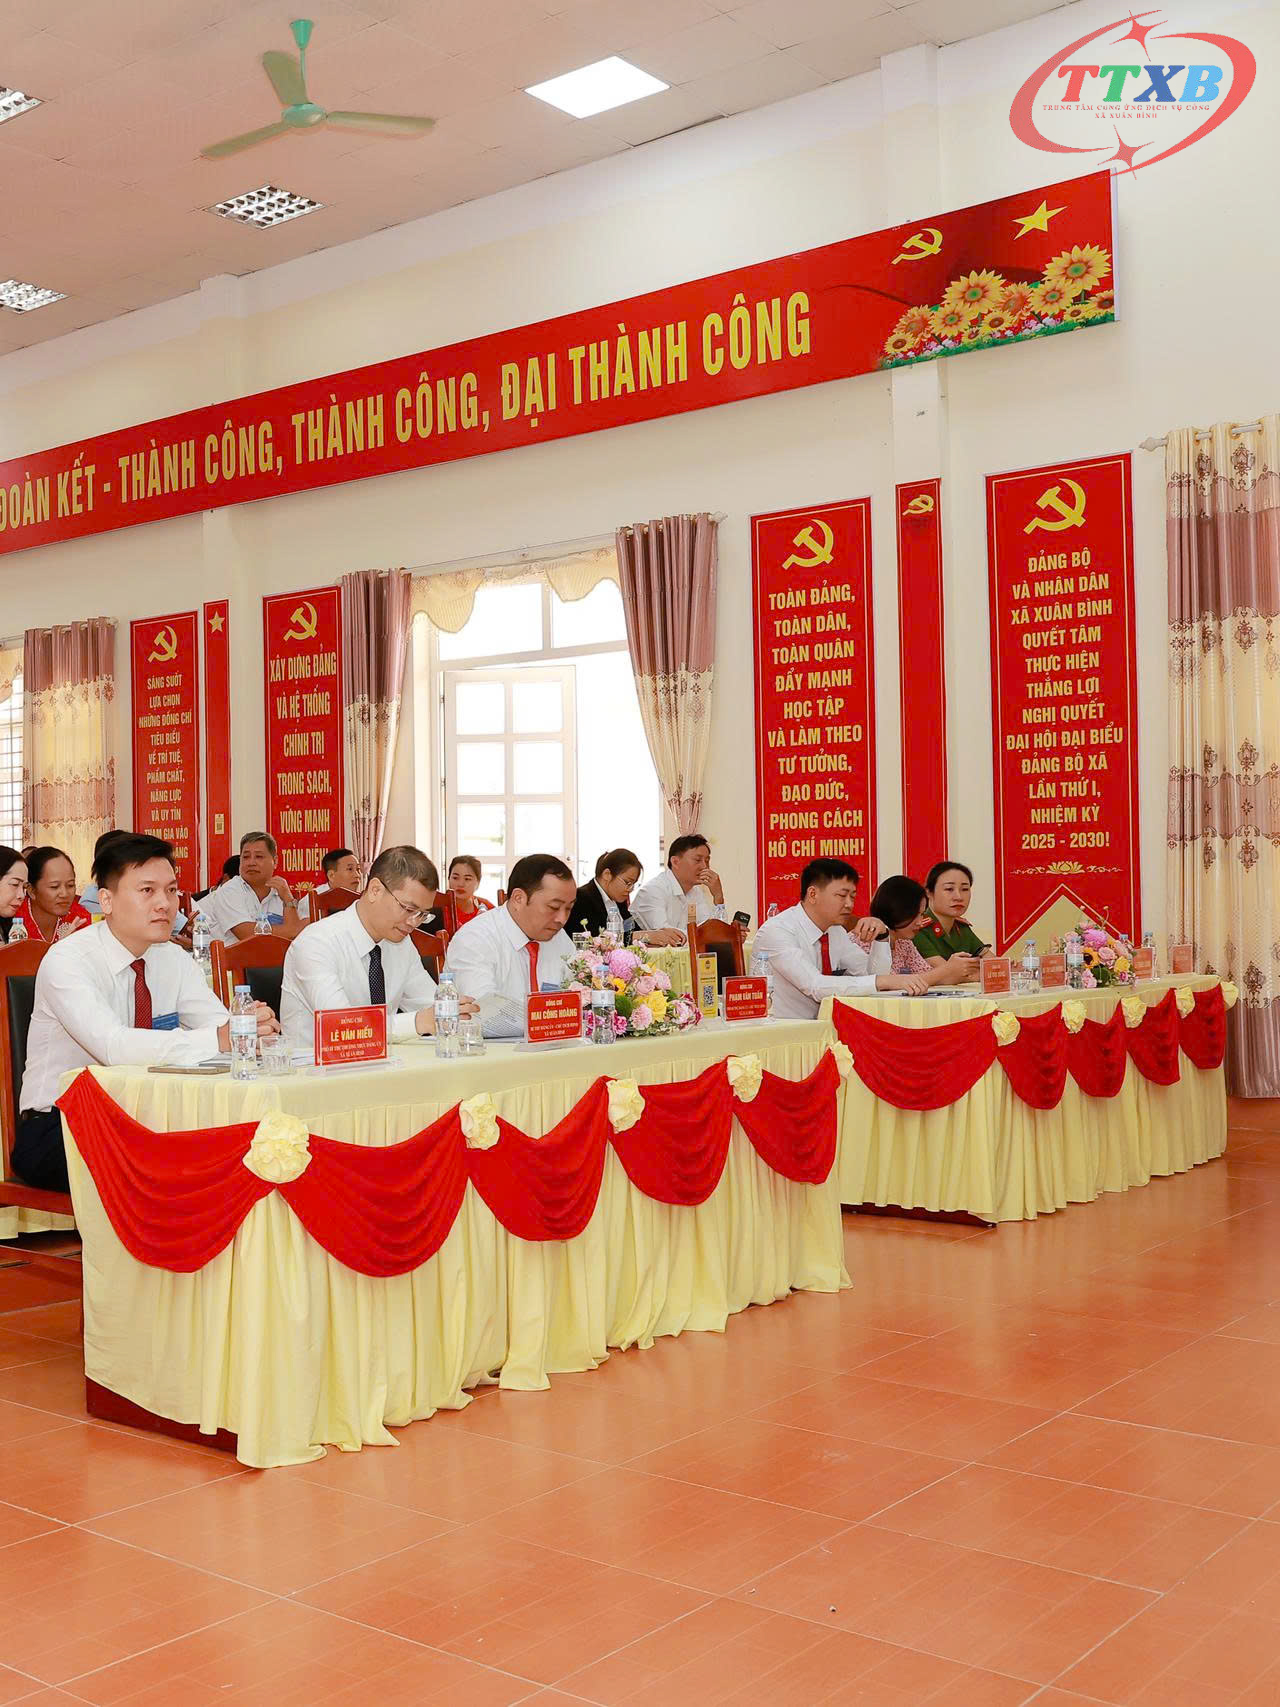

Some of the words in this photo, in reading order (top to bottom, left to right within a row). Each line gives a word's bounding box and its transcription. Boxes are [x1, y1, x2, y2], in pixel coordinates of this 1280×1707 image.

[57, 452, 95, 518] KẾT
[119, 439, 195, 503] THÀNH
[205, 419, 283, 484] CÔNG,
[291, 394, 384, 464] THÀNH
[395, 371, 489, 443] CÔNG,
[501, 353, 556, 427] ĐẠI
[568, 322, 688, 405] THÀNH
[702, 291, 810, 375] CÔNG
[1028, 550, 1067, 573] ĐẢNG
[1072, 547, 1090, 569] BỘ
[769, 588, 806, 610] TOÀN
[810, 580, 855, 605] ĐẢNG,
[1012, 581, 1030, 600] VÀ
[1035, 576, 1074, 597] NHÂN
[1079, 572, 1109, 592] DÂN
[774, 615, 811, 637] TOÀN
[816, 611, 850, 632] DÂN,
[1011, 606, 1030, 625] XÃ
[1034, 602, 1072, 622] XUÂN
[1077, 598, 1112, 617] BÌNH
[1023, 625, 1066, 650] QUYẾT
[1070, 625, 1101, 644] TÂM
[270, 654, 285, 682] XÂY
[288, 654, 311, 684] DỰNG
[313, 643, 336, 677] ĐẢNG
[772, 643, 809, 664] TOÀN
[814, 638, 854, 662] QUÂN
[1025, 655, 1061, 675] THỰC
[1066, 650, 1099, 672] HIỆN
[147, 675, 164, 689] SÁNG
[166, 670, 182, 688] SUỐT
[776, 667, 803, 692] ĐẨY
[808, 669, 851, 691] MẠNH
[1078, 677, 1099, 697] LỢI
[181, 708, 192, 724] CHÍ
[277, 692, 287, 719] VÀ
[290, 690, 300, 723] HỆ
[302, 684, 330, 717] THỐNG
[784, 700, 812, 722] HỌC
[817, 695, 844, 719] TẬP
[1022, 707, 1056, 725] NGHỊ
[1061, 698, 1104, 722] QUYẾT
[284, 728, 309, 757] CHÍNH
[311, 731, 324, 759] TRỊ
[768, 727, 786, 747] VÀ
[790, 725, 820, 746] LÀM
[825, 725, 862, 743] THEO
[1007, 734, 1029, 752] ĐẠI
[1034, 729, 1056, 751] HỘI
[1062, 730, 1085, 749] ĐẠI
[1090, 722, 1123, 744] BIỂU
[158, 750, 168, 764] TRÍ
[778, 755, 797, 774] TƯ
[800, 748, 852, 773] TƯỞNG,
[1022, 752, 1060, 774] ĐẢNG
[1065, 753, 1083, 774] BỘ
[1088, 752, 1108, 770] XÃ
[277, 772, 304, 795] TRONG
[307, 770, 332, 798] SẠCH,
[782, 784, 810, 805] ĐẠO
[815, 778, 848, 800] ĐỨC,
[1029, 778, 1056, 799] LẦN
[1060, 777, 1089, 797] THỨ
[151, 807, 159, 821] VÀ
[161, 809, 169, 821] UY
[305, 809, 330, 837] MẠNH
[770, 812, 818, 830] PHONG
[823, 807, 862, 827] CÁCH
[1031, 805, 1077, 826] NHIỆM
[1081, 803, 1099, 822] KỲ
[164, 829, 174, 839] GIA
[176, 826, 188, 839] VÀO
[1022, 834, 1055, 849] 2025
[1070, 832, 1110, 848] 2030!
[282, 843, 303, 872] TOÀN
[768, 835, 787, 857] HỒ
[792, 836, 815, 856] CHÍ
[820, 838, 864, 856] MINH!
[331, 1029, 339, 1042] LÊ
[341, 1028, 355, 1041] VĂN
[357, 1025, 372, 1039] HIẾU
